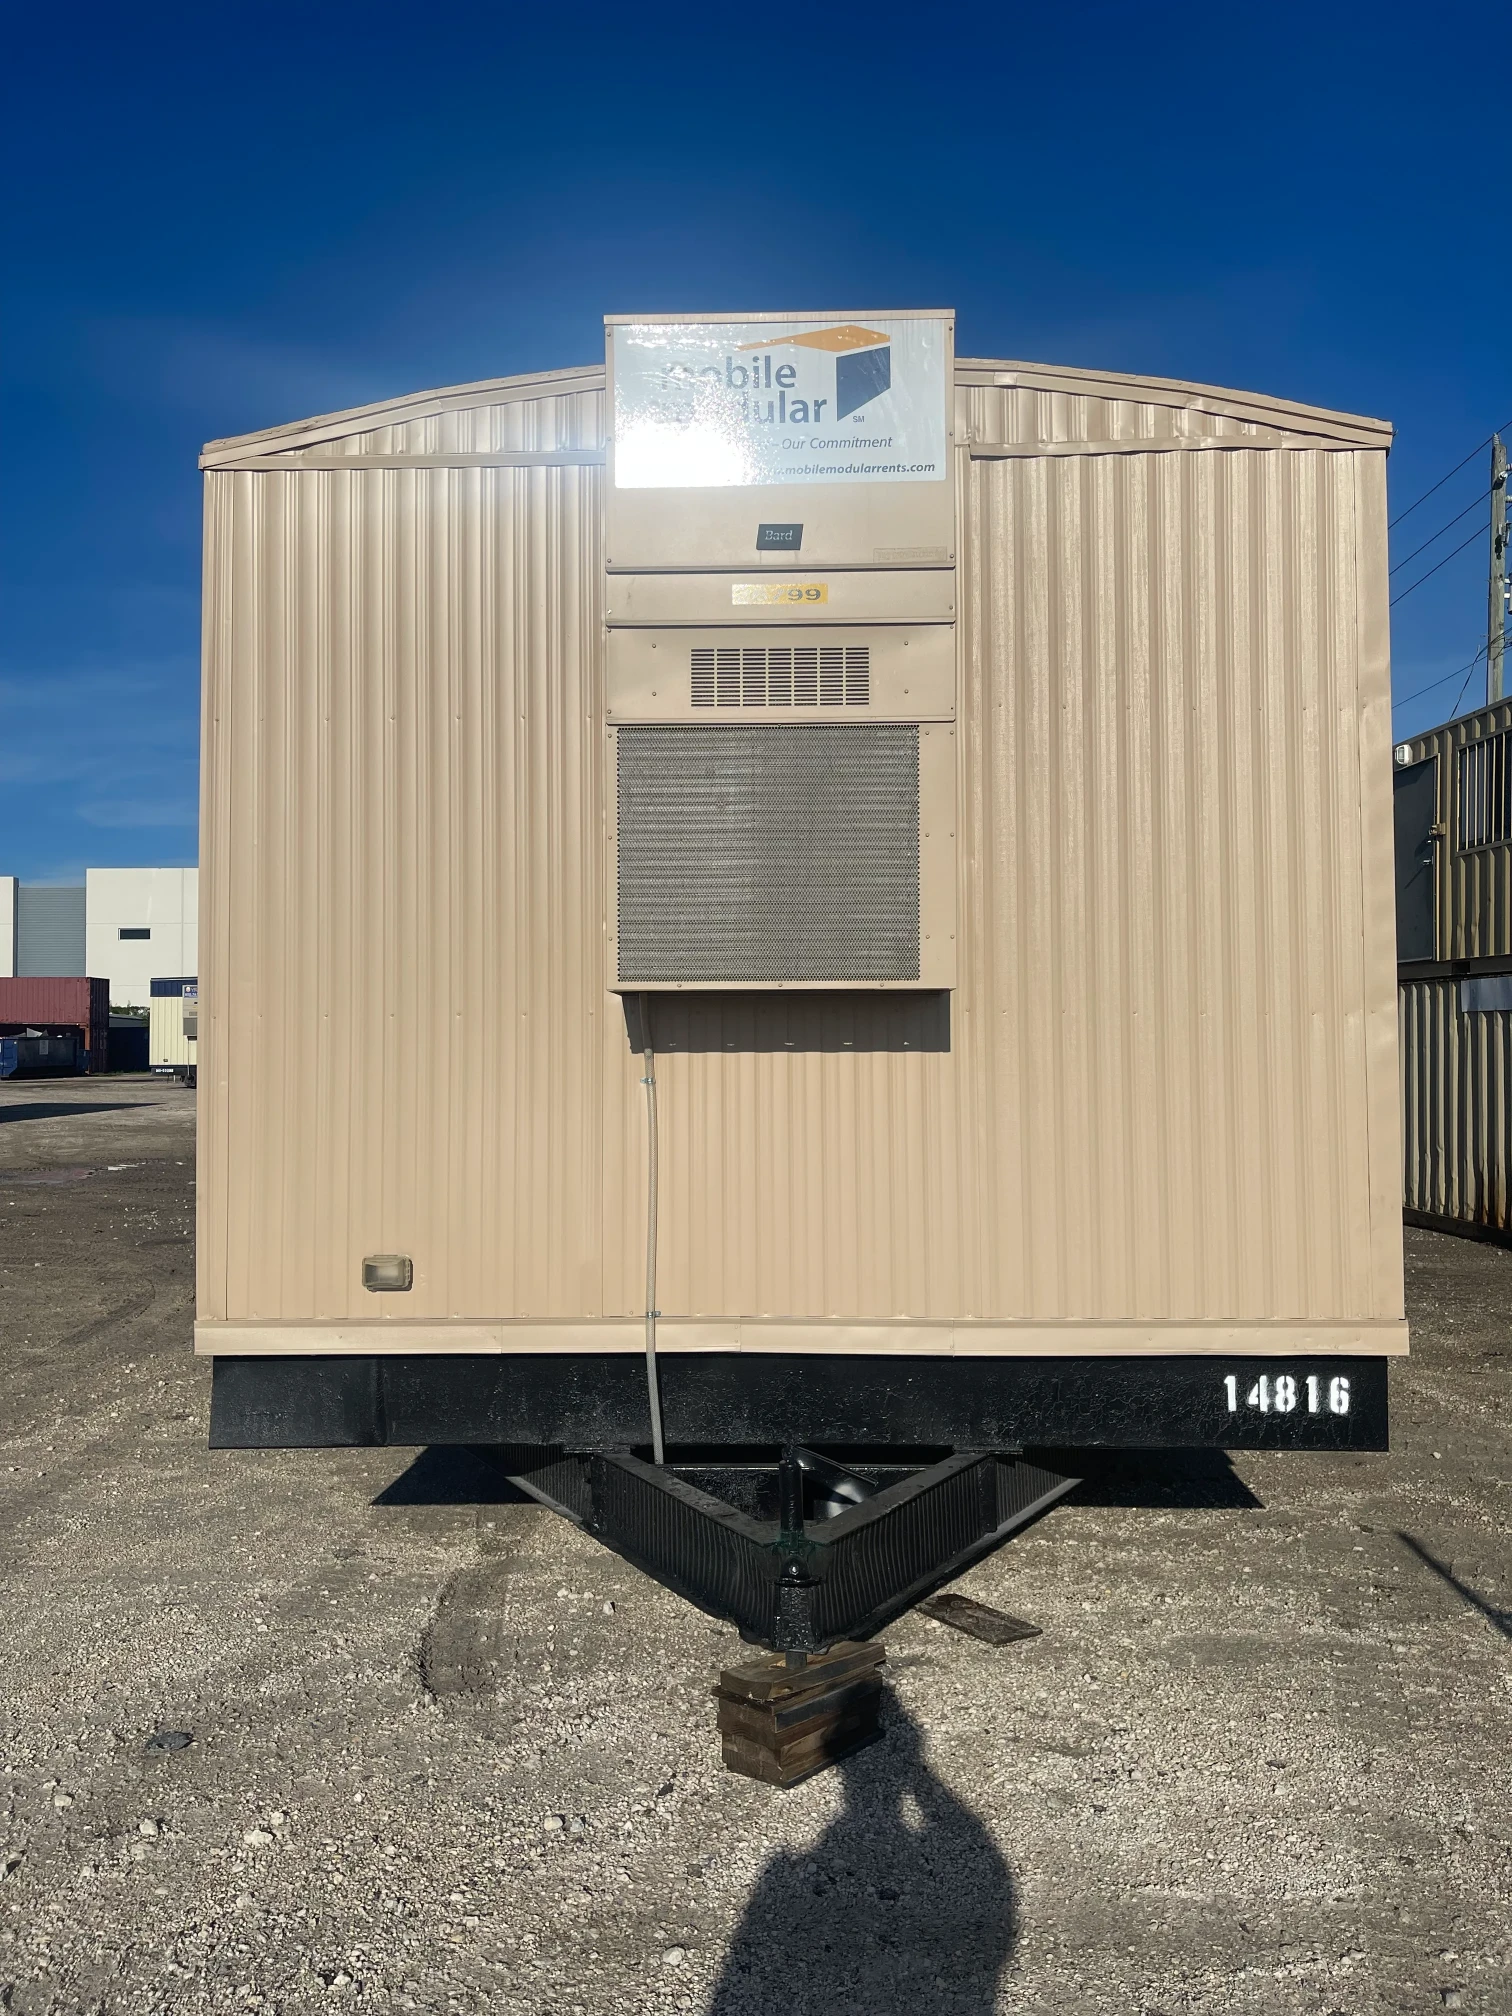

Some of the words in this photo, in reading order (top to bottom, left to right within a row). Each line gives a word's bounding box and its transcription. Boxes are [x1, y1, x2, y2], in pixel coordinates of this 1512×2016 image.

[852, 415, 865, 423] SM
[782, 438, 806, 450] Our
[810, 436, 893, 449] Commitment
[765, 529, 793, 541] Bard
[1223, 1374, 1351, 1415] 14816
